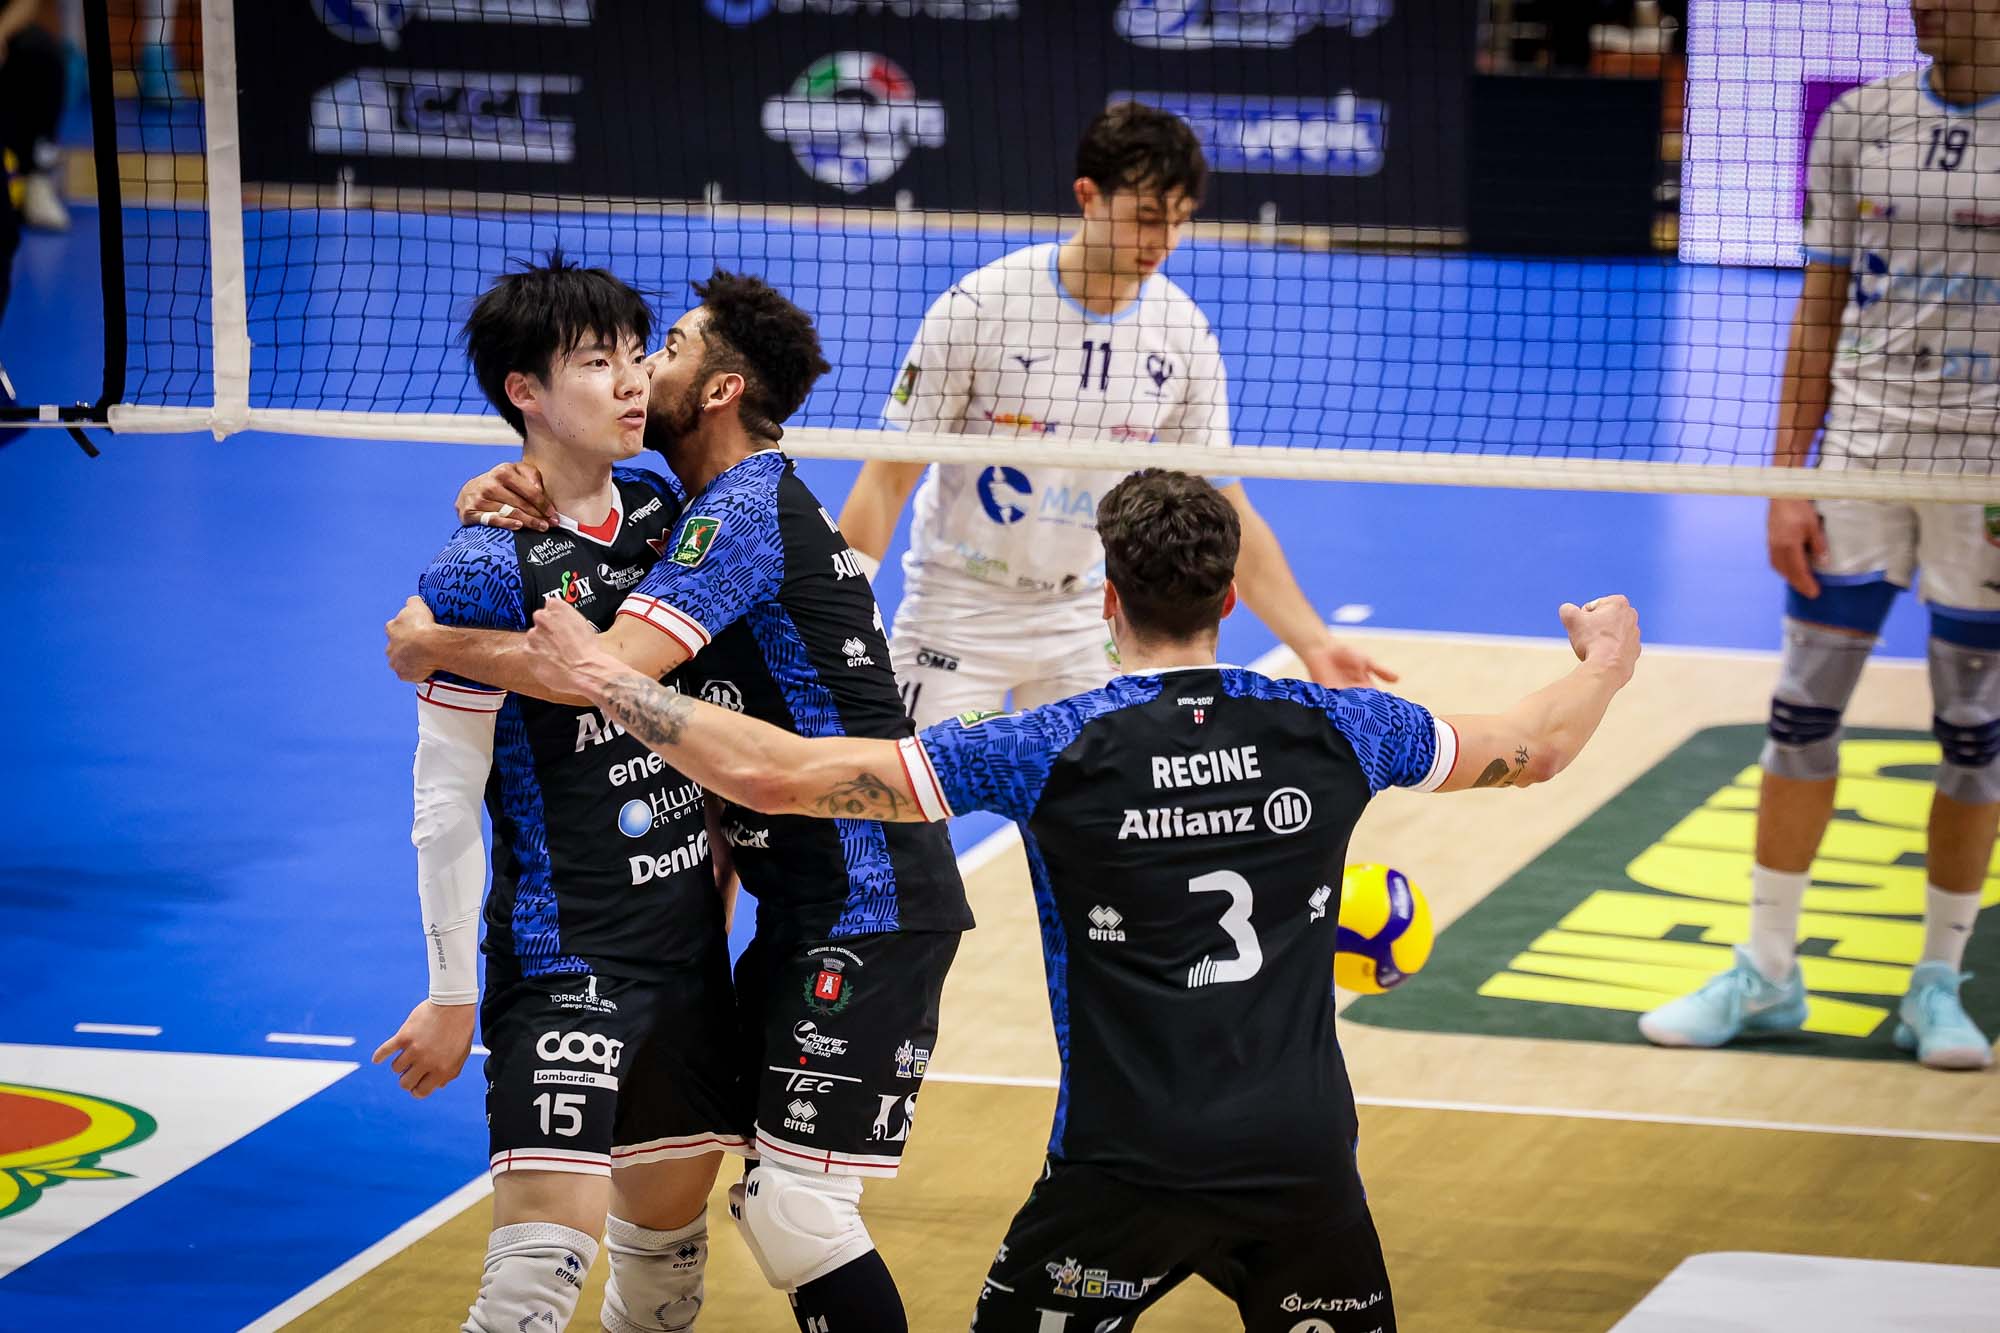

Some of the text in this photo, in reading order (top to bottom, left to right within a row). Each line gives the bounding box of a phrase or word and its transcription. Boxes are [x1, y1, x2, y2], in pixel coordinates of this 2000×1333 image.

[1923, 127, 1970, 172] 19
[1080, 340, 1112, 391] 11
[533, 538, 554, 554] BMC
[538, 540, 577, 561] PHARMA
[573, 594, 598, 609] ASHION
[608, 751, 666, 787] ene
[1151, 744, 1263, 789] RECINE
[1117, 806, 1256, 841] Allianz
[1088, 926, 1127, 943] errea
[1187, 868, 1264, 989] 3
[536, 1031, 624, 1075] coop
[536, 1072, 596, 1084] Lombardia
[769, 1065, 863, 1094] TEC
[533, 1092, 587, 1137] 15
[784, 1117, 816, 1135] errea
